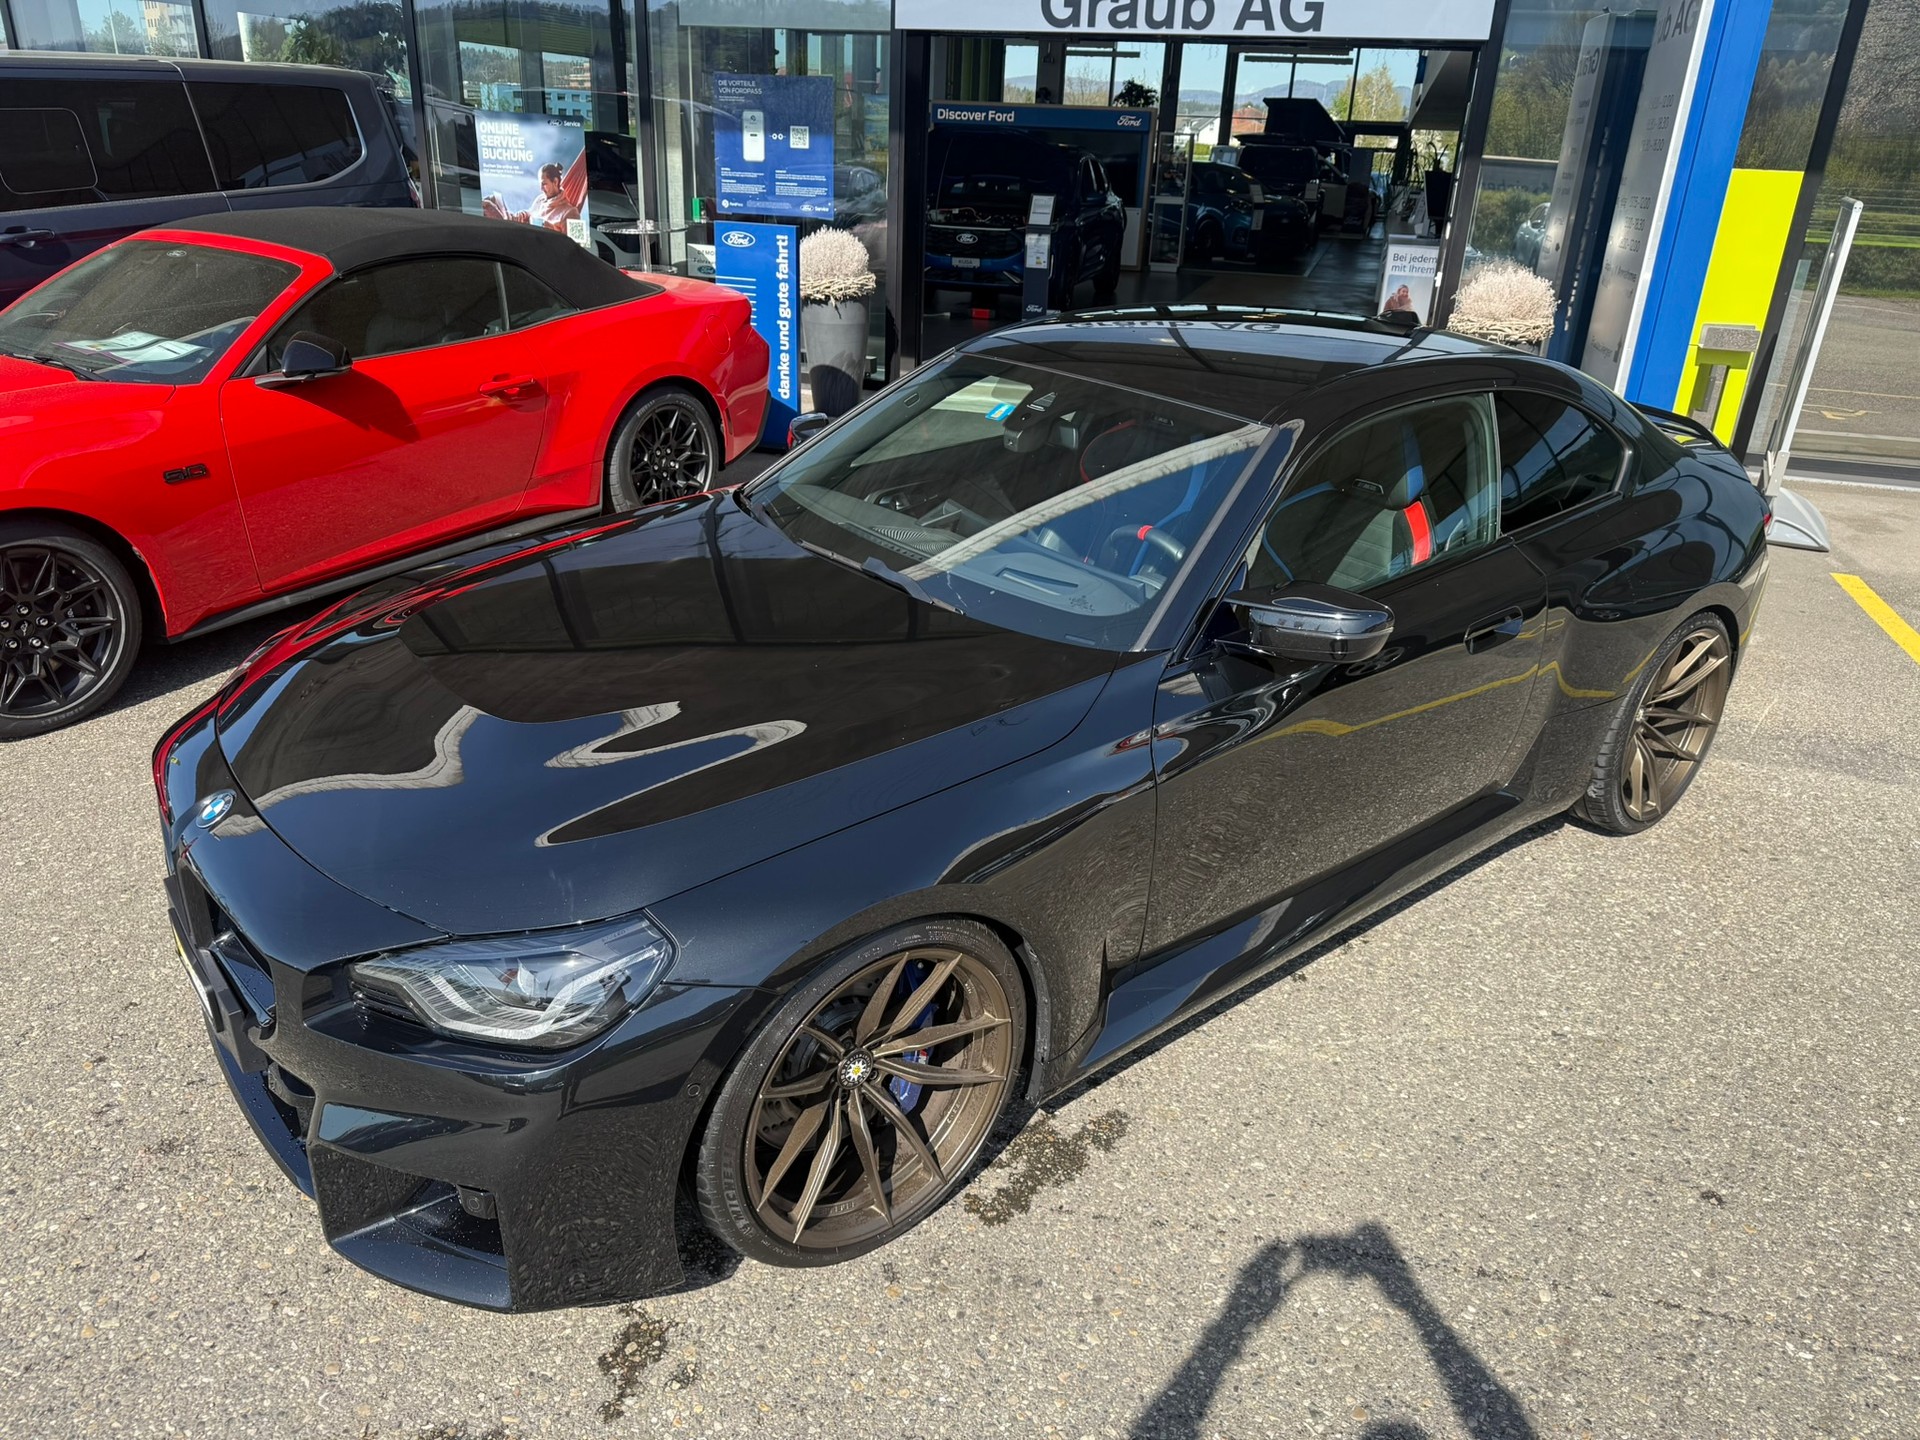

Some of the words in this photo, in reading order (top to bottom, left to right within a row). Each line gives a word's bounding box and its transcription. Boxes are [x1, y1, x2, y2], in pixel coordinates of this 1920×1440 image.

[1041, 0, 1216, 30] Graub
[1233, 0, 1326, 33] AG
[937, 108, 986, 121] Discover
[988, 110, 1015, 122] Ford
[1117, 115, 1142, 127] Ford
[480, 121, 520, 134] ONLINE
[563, 120, 581, 128] Service
[481, 135, 526, 148] SERVICE
[482, 148, 534, 162] BUCHUNG
[727, 231, 751, 246] Ford
[776, 234, 789, 280] fahrt!
[1393, 253, 1407, 262] Bei
[1408, 254, 1438, 264] jedem
[1391, 264, 1406, 272] mit
[1409, 264, 1435, 274] Ihrem
[778, 282, 791, 319] gute
[1026, 304, 1043, 313] Ford
[776, 320, 789, 350] und
[777, 351, 790, 399] danke
